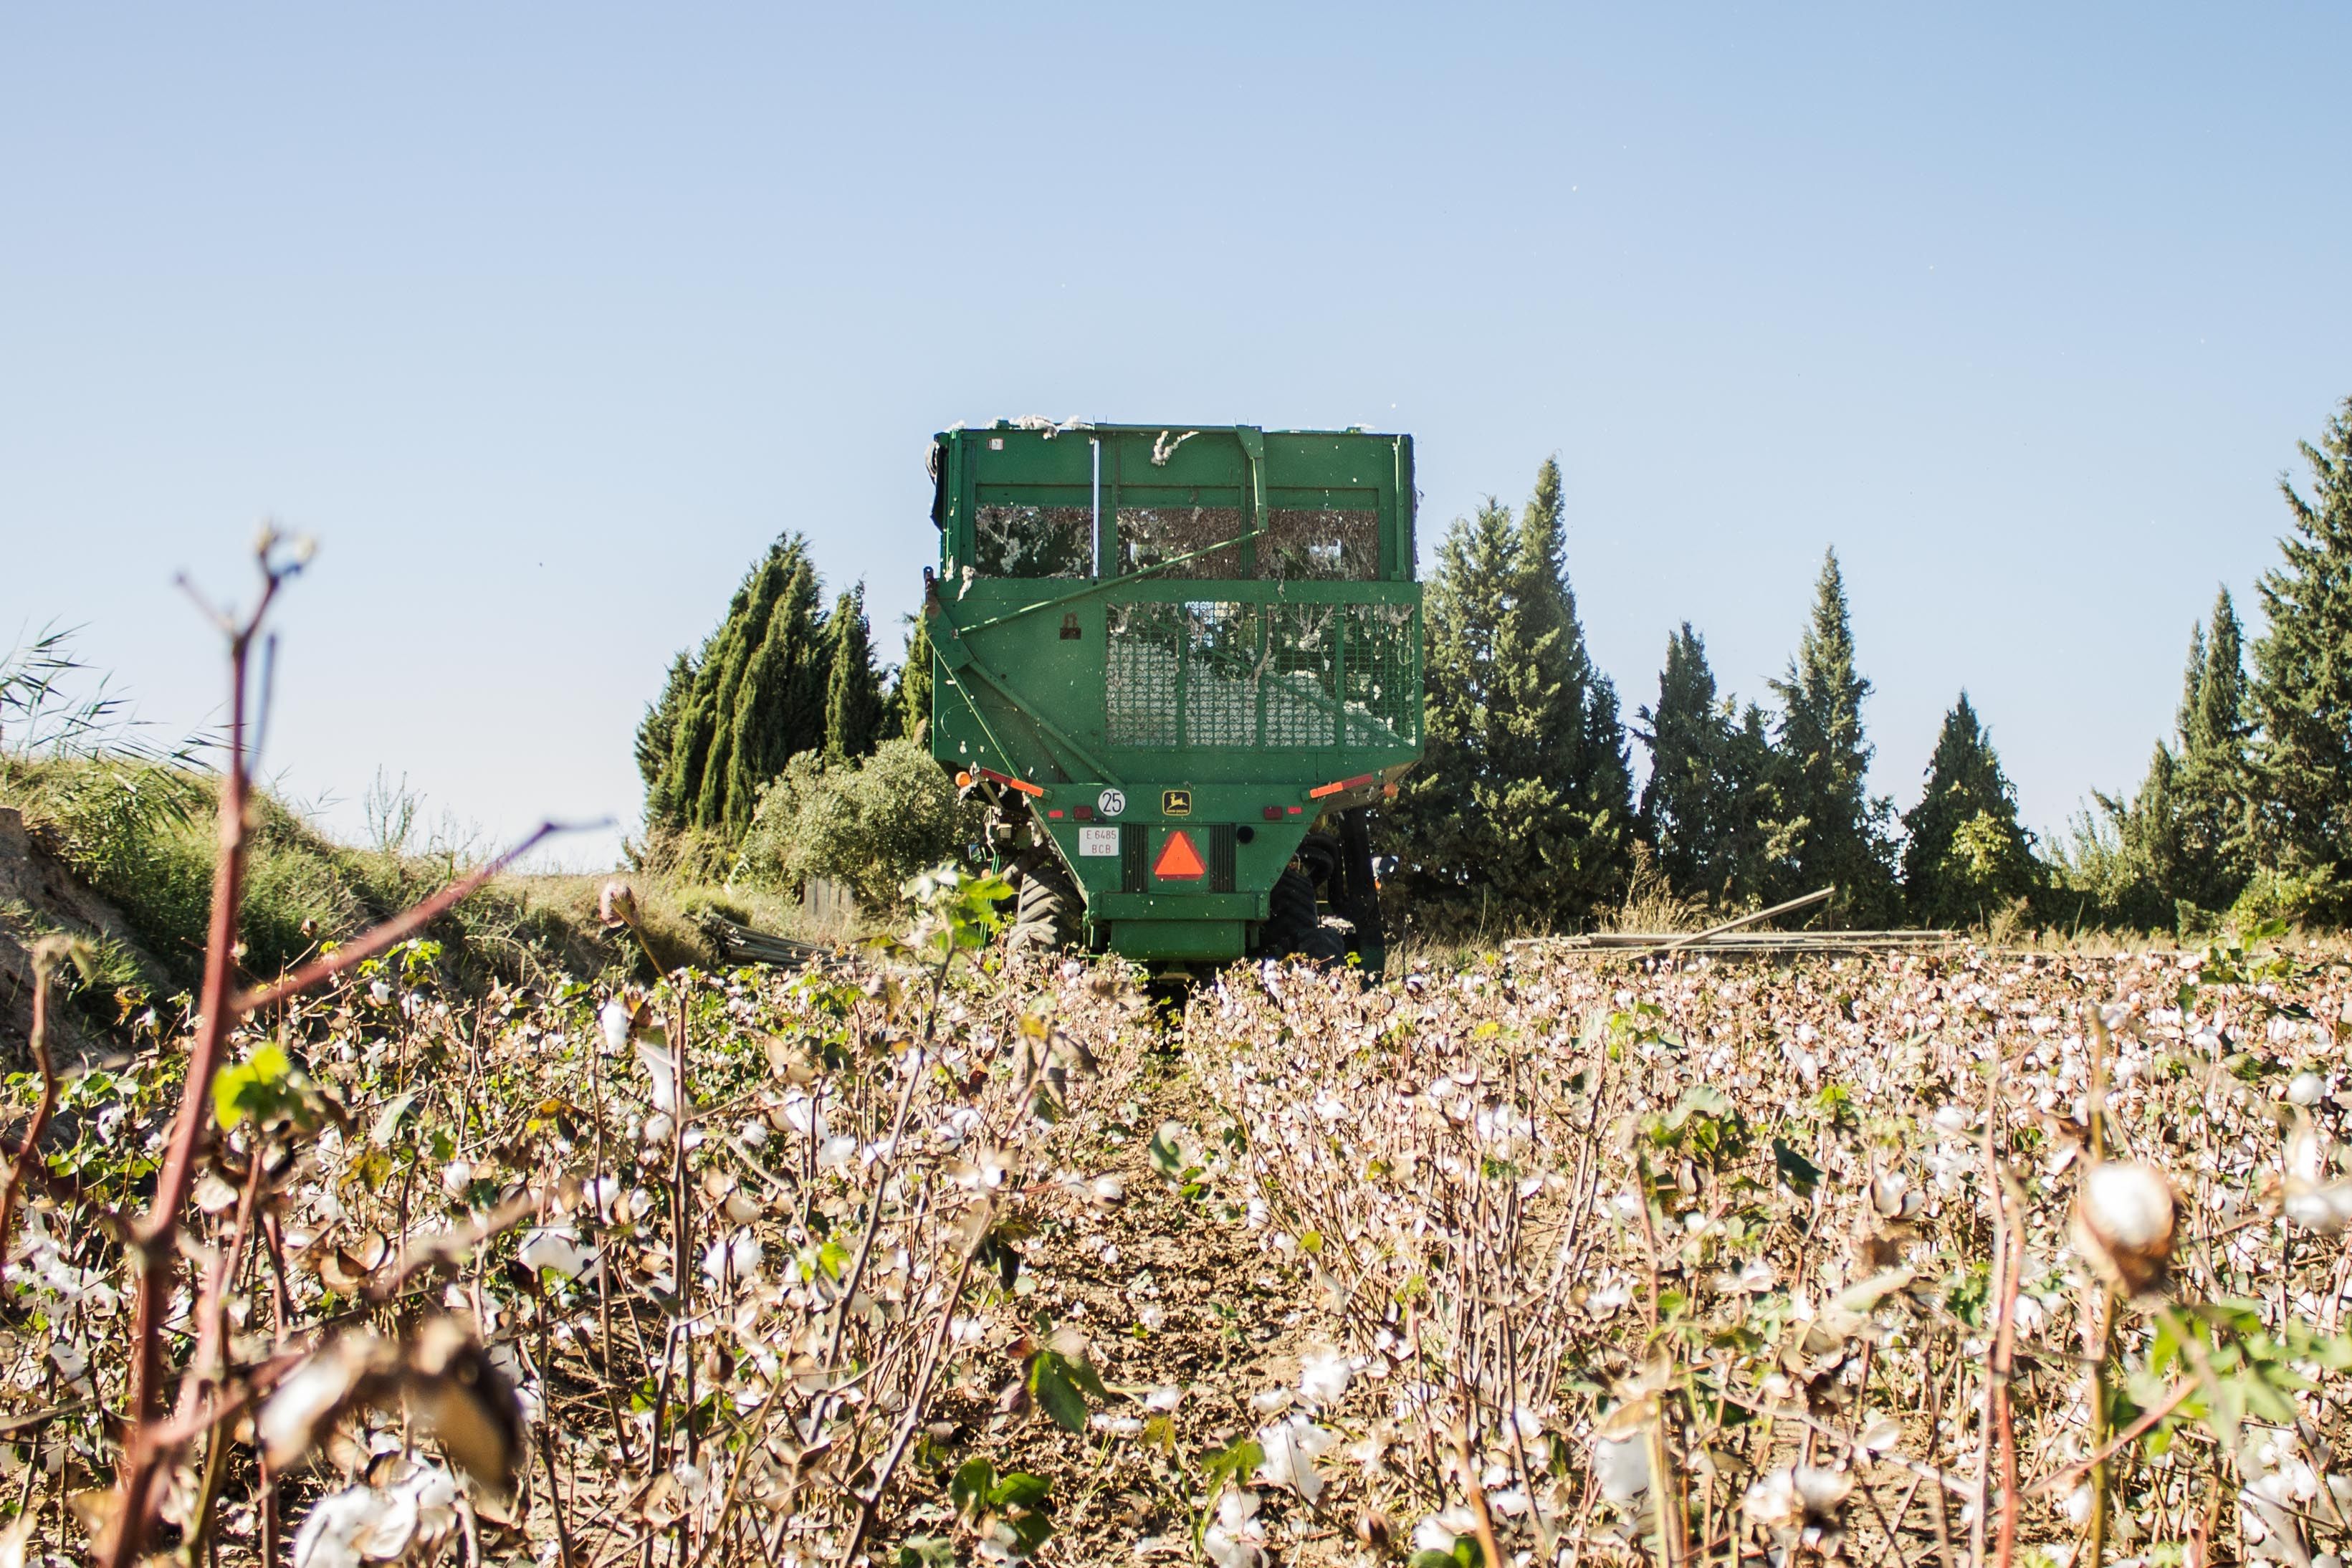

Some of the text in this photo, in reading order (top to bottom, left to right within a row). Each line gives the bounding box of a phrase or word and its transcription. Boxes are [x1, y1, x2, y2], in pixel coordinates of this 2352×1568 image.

[1102, 792, 1122, 813] 25
[1086, 831, 1117, 840] E 6485
[1091, 844, 1111, 854] BCB
